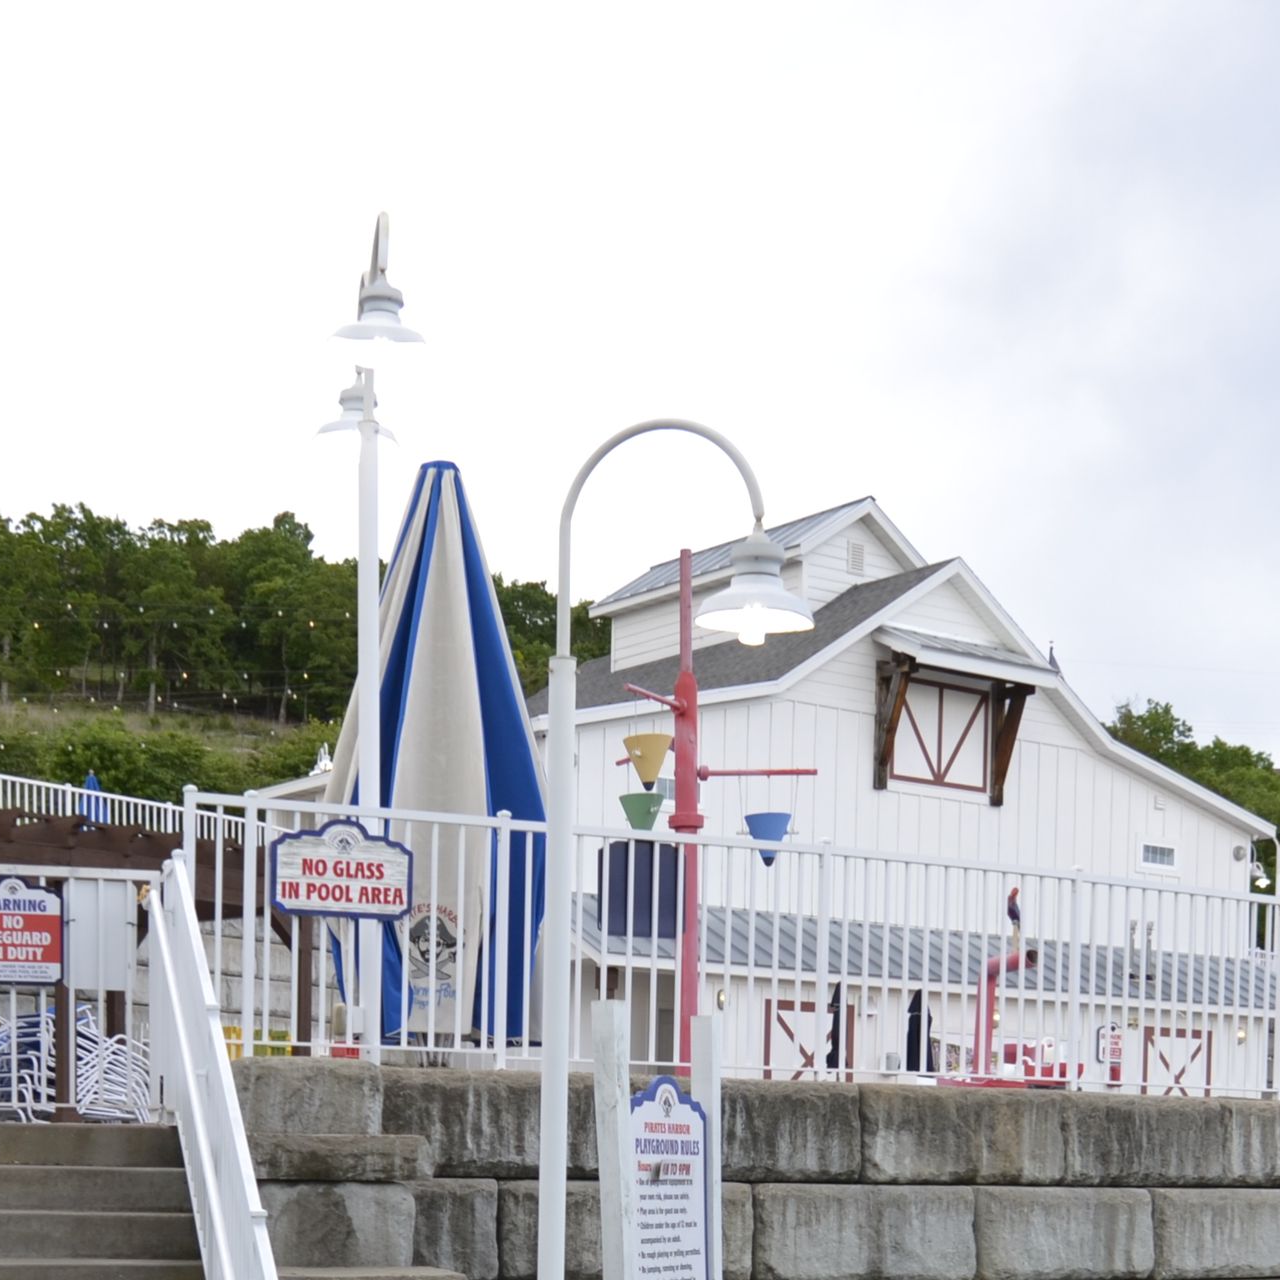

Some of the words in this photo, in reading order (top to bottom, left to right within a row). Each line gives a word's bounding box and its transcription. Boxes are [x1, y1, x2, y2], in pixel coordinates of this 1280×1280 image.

[302, 858, 327, 877] NO
[333, 859, 384, 880] GLASS
[281, 881, 300, 899] IN
[306, 883, 353, 903] POOL
[358, 886, 404, 906] AREA
[2, 915, 24, 929] NO
[8, 946, 44, 961] DUTY
[644, 1122, 666, 1134] PIRATES
[668, 1123, 690, 1135] HARBOR
[635, 1138, 679, 1155] PLAYGROUND
[681, 1140, 699, 1156] RULES
